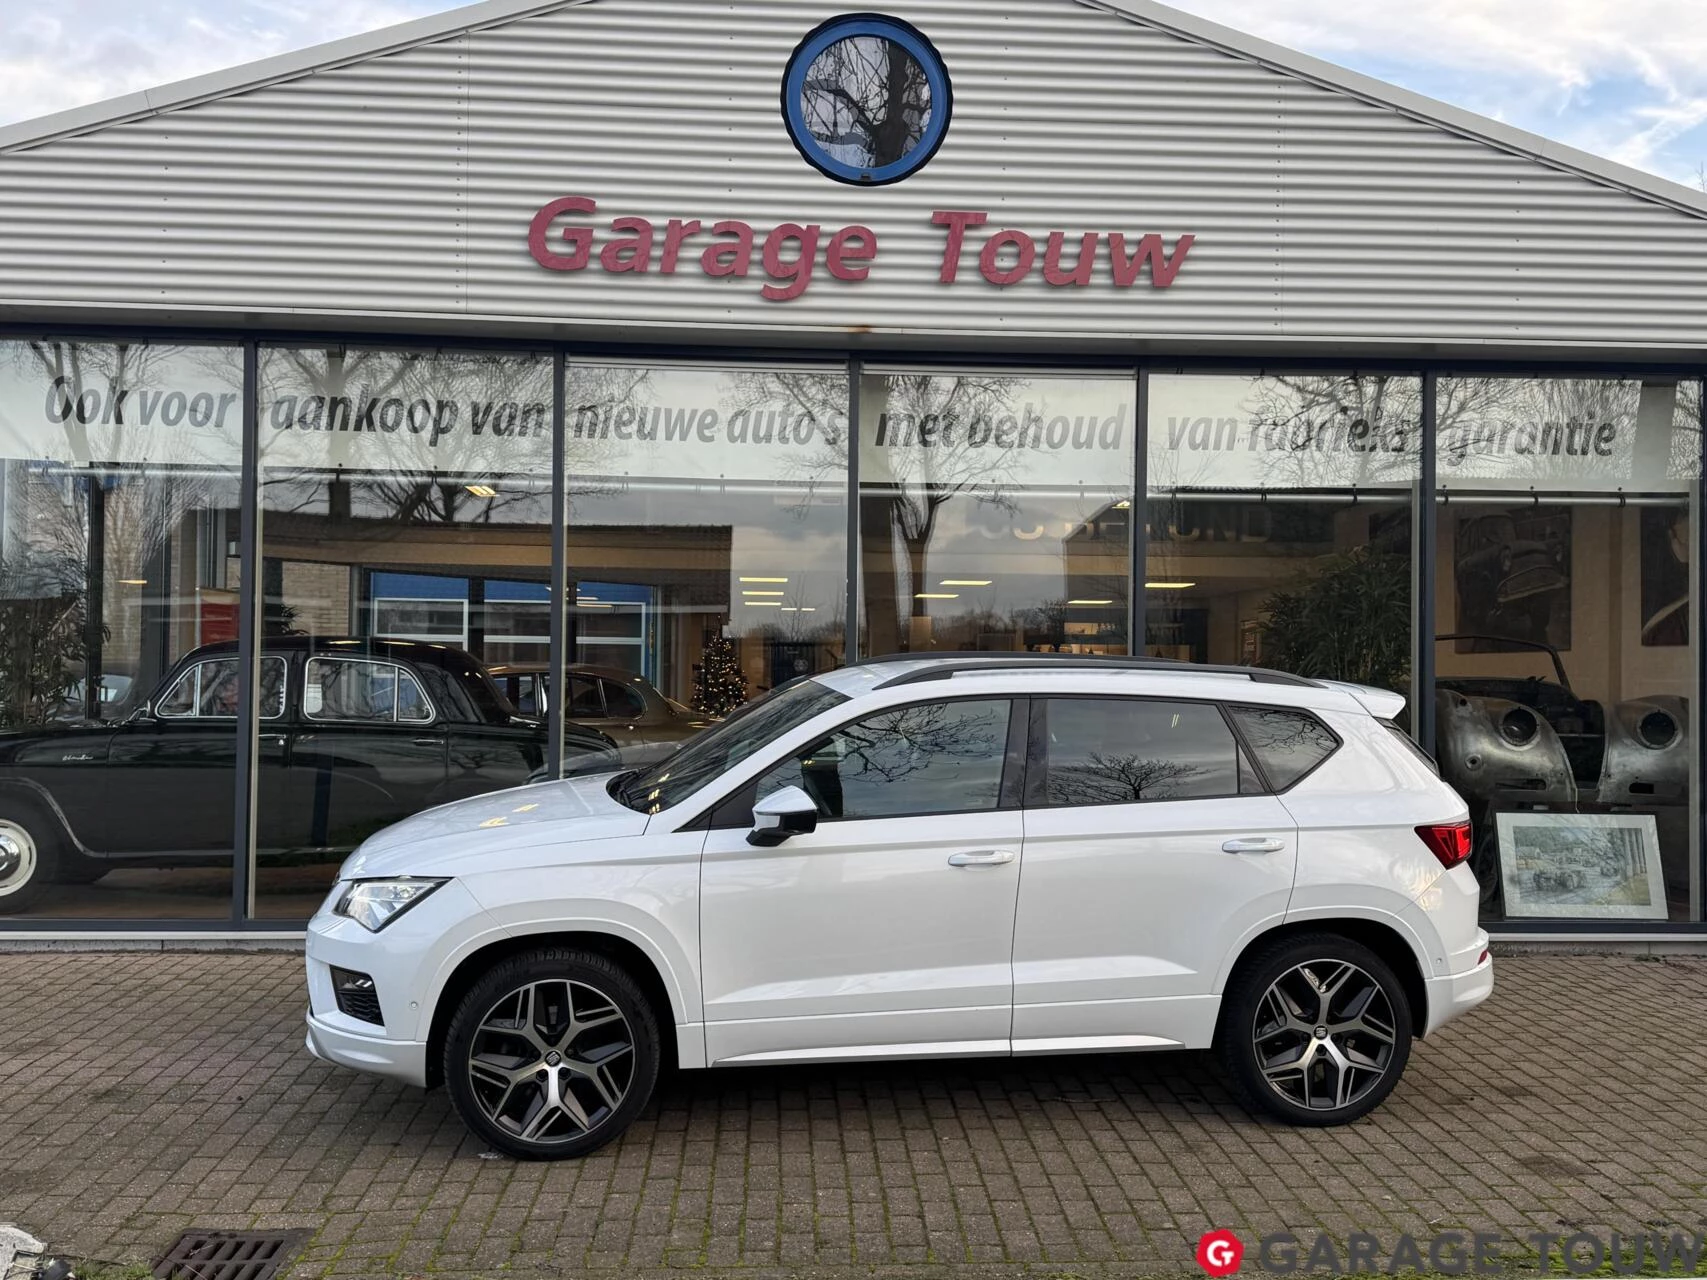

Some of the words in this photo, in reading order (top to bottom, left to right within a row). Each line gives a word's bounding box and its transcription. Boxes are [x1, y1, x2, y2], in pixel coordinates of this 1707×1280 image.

[528, 195, 877, 300] Garage
[931, 209, 1196, 287] Touw
[45, 375, 128, 426] Ook
[138, 390, 236, 428] voor
[270, 383, 458, 447] aankoop
[471, 400, 546, 437] van
[573, 395, 719, 443] nieuwe
[875, 408, 960, 448] met
[967, 402, 1128, 451] behoud
[1167, 416, 1236, 452] van
